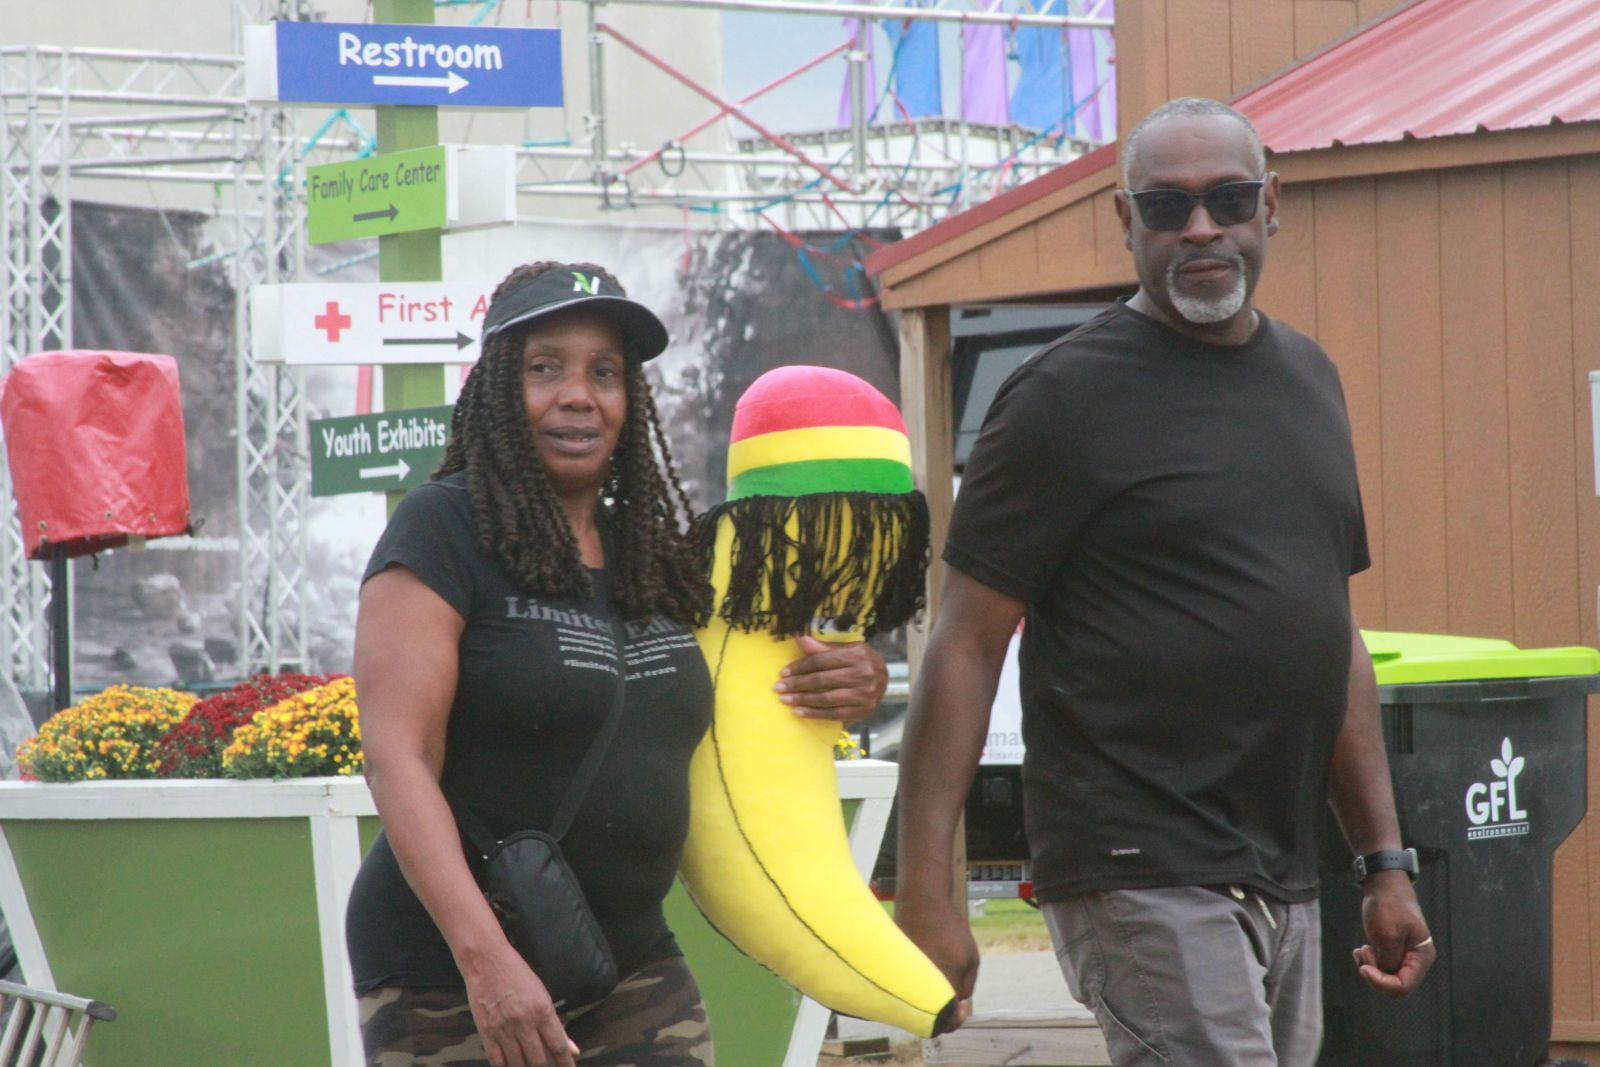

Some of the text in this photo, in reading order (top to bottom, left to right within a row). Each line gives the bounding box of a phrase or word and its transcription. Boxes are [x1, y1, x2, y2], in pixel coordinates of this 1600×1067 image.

[338, 31, 503, 71] Restroom
[312, 160, 440, 203] Family Care Center
[378, 293, 489, 324] First A
[321, 416, 447, 459] Youth Exhibits
[1465, 757, 1528, 825] GFL
[1467, 824, 1530, 839] environmental
